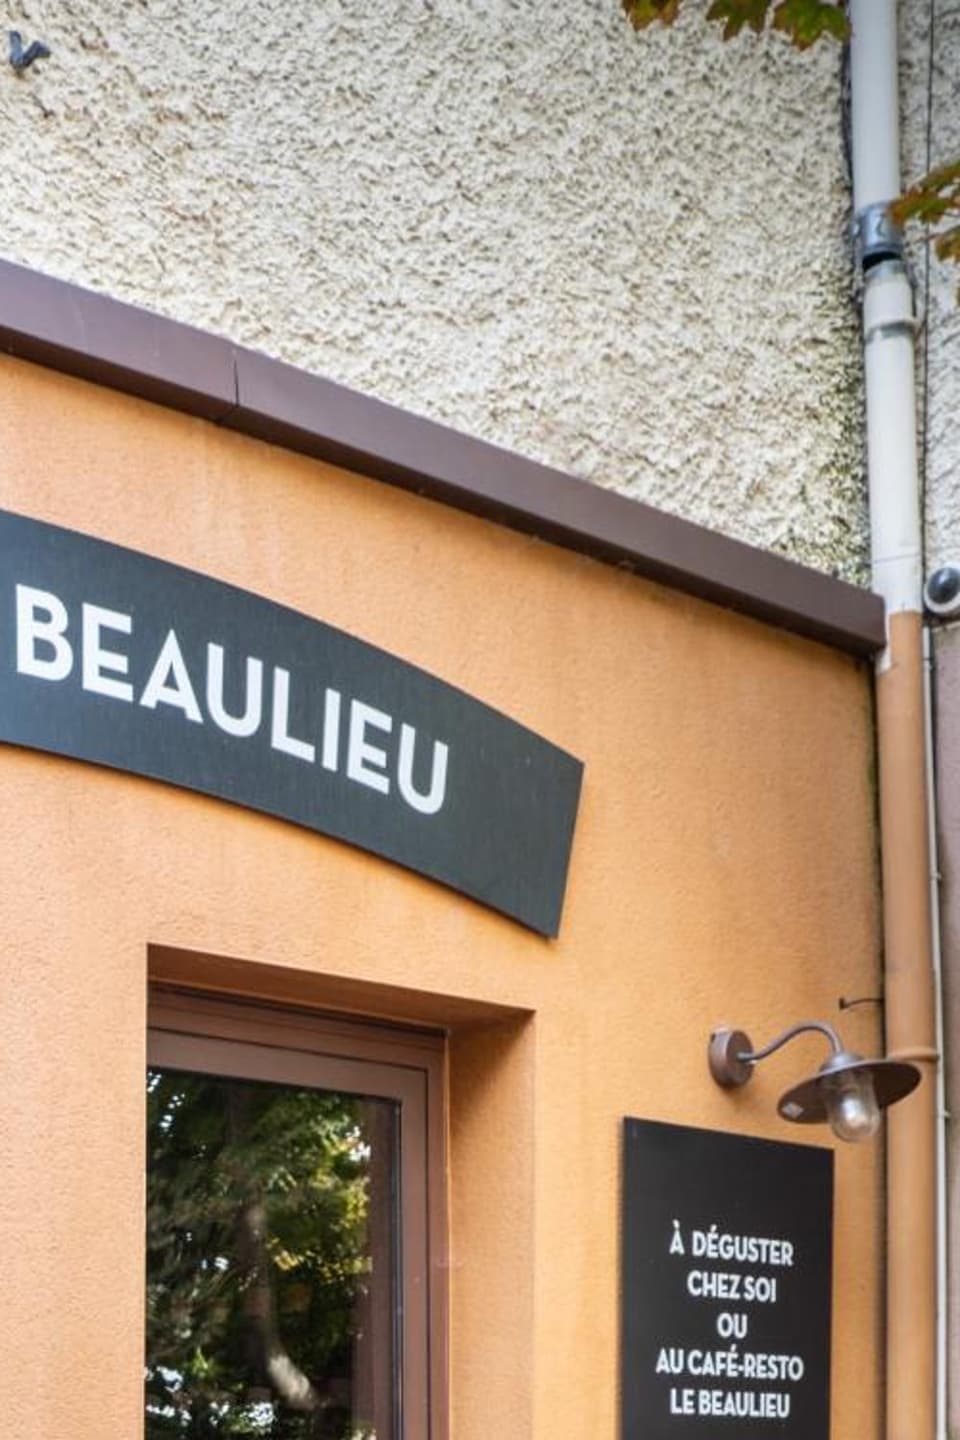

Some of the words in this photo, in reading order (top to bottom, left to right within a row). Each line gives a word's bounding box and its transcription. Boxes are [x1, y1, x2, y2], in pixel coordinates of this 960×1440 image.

[16, 583, 450, 815] BEAULIEU
[669, 1219, 685, 1255] À
[692, 1224, 794, 1266] DÉGUSTER
[687, 1270, 740, 1299] CHEZ
[743, 1276, 777, 1303] SOI
[717, 1312, 748, 1339] OU
[655, 1348, 684, 1374] AU
[687, 1344, 804, 1381] CAFÉ-RESTO
[670, 1388, 695, 1414] LE
[698, 1389, 790, 1418] BEAULIEU
